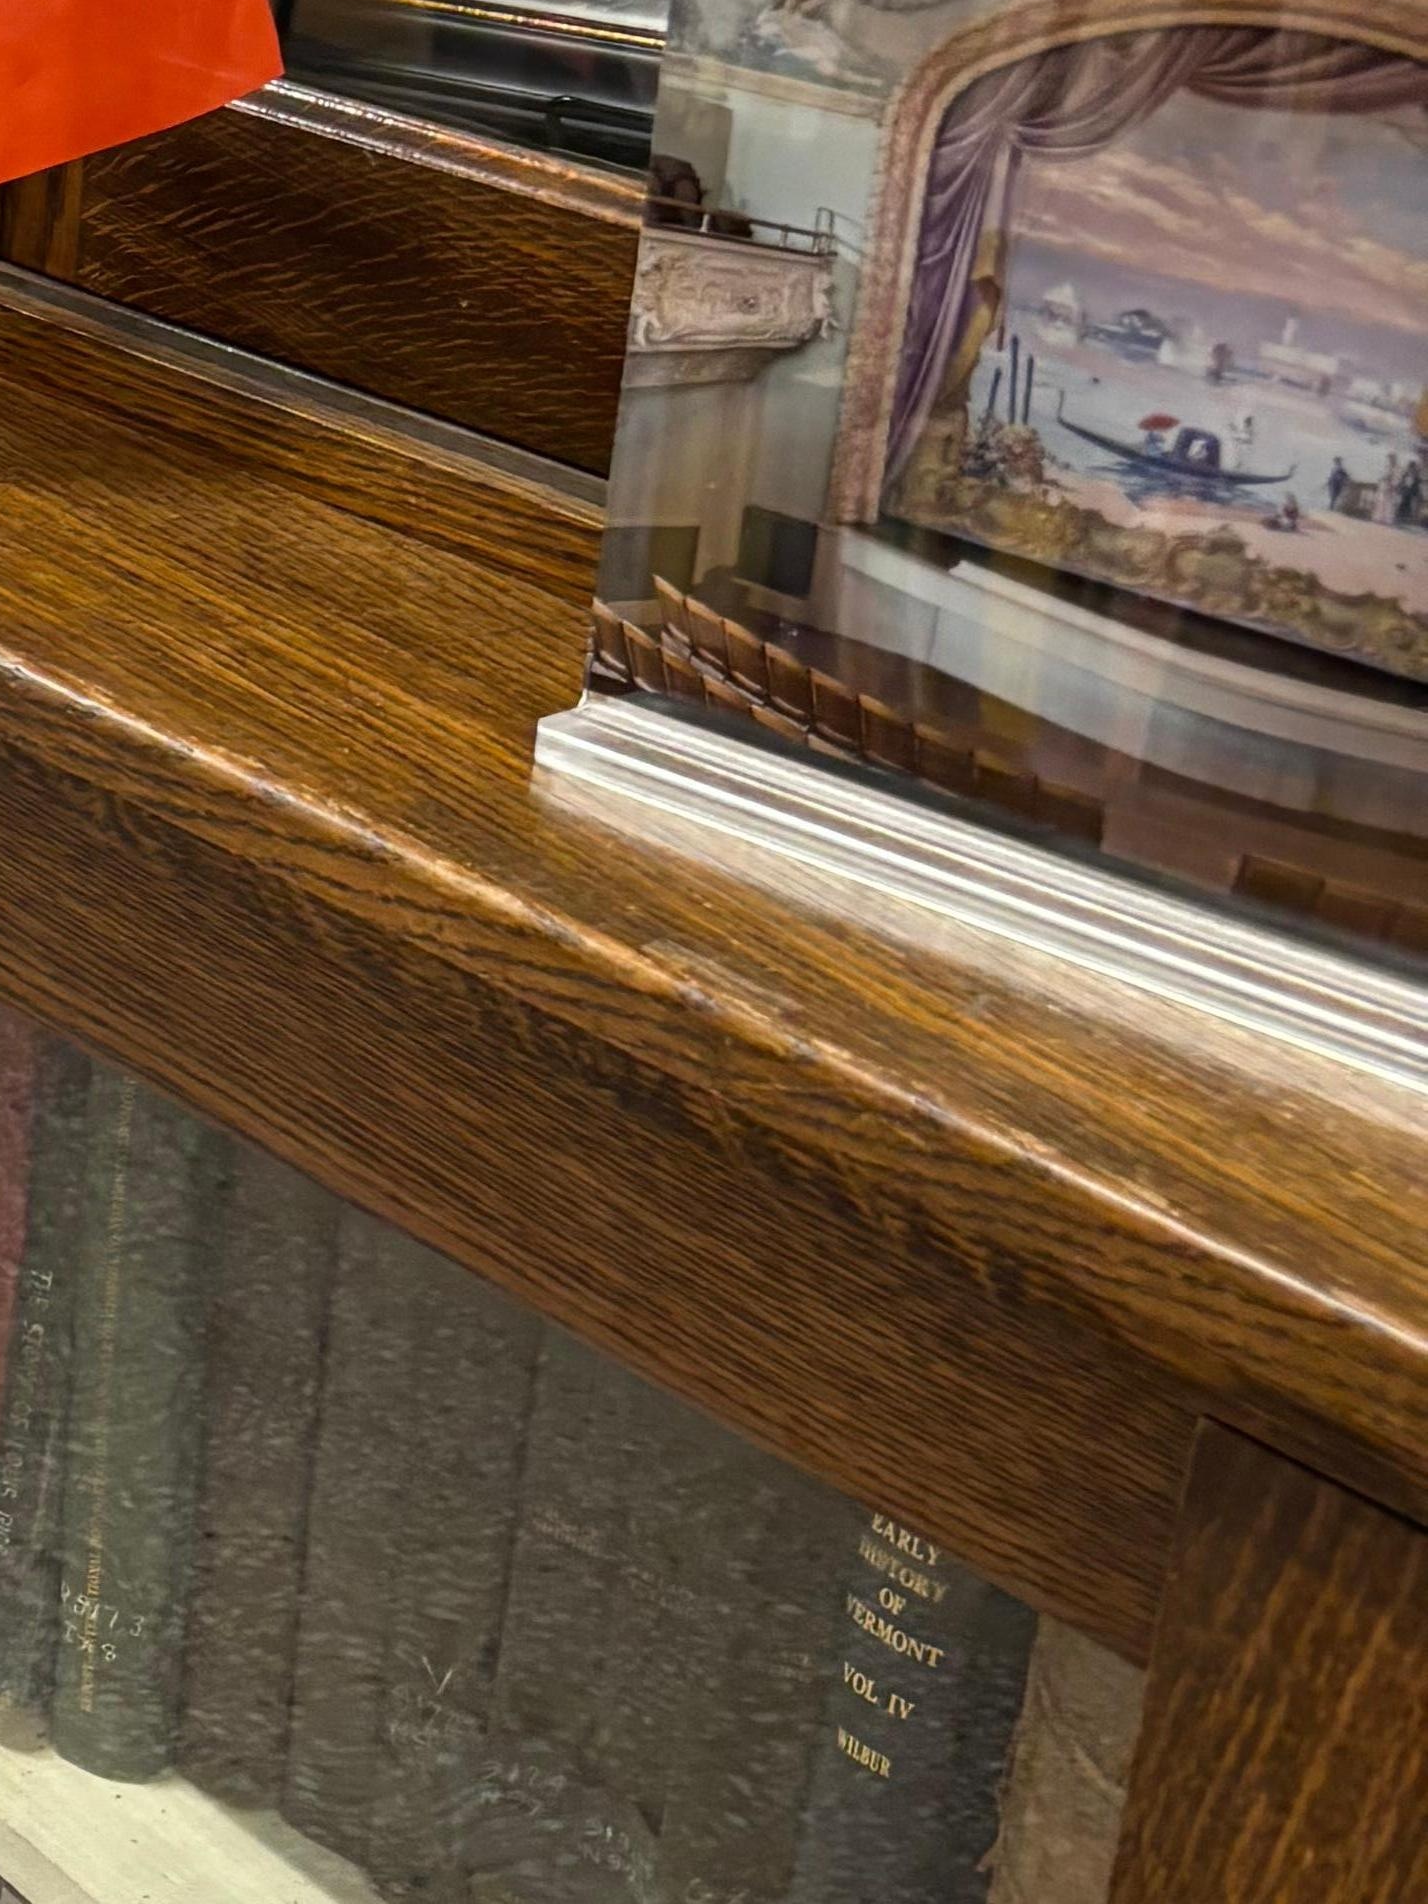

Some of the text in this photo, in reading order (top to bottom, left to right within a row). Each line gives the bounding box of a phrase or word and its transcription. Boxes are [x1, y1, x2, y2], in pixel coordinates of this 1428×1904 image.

[871, 1512, 941, 1566] EARLY
[878, 1586, 907, 1616] OF
[847, 1593, 945, 1669] VERMONT
[843, 1660, 916, 1720] VOL IV
[837, 1725, 891, 1779] WILBUR
